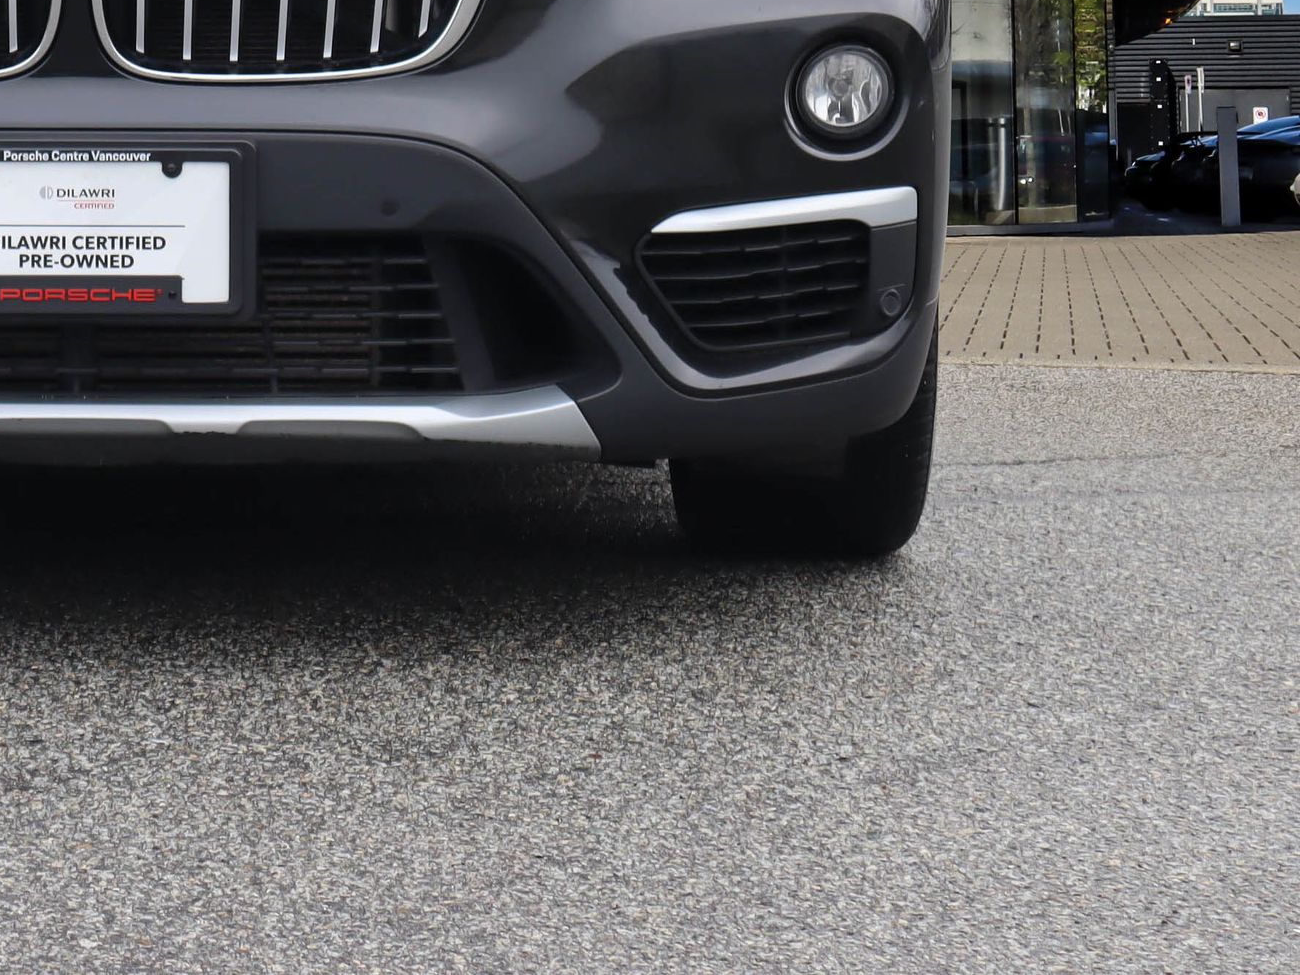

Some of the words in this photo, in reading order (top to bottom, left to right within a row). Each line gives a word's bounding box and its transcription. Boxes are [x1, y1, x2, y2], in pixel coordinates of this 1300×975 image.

[3, 150, 49, 162] Porsche
[51, 150, 89, 162] Centre
[91, 150, 151, 162] Vancouver
[56, 188, 115, 198] DILAWRI
[72, 235, 166, 251] CERTIFIED
[18, 254, 135, 269] PRE-OWNED
[0, 288, 157, 302] PORSCHE
